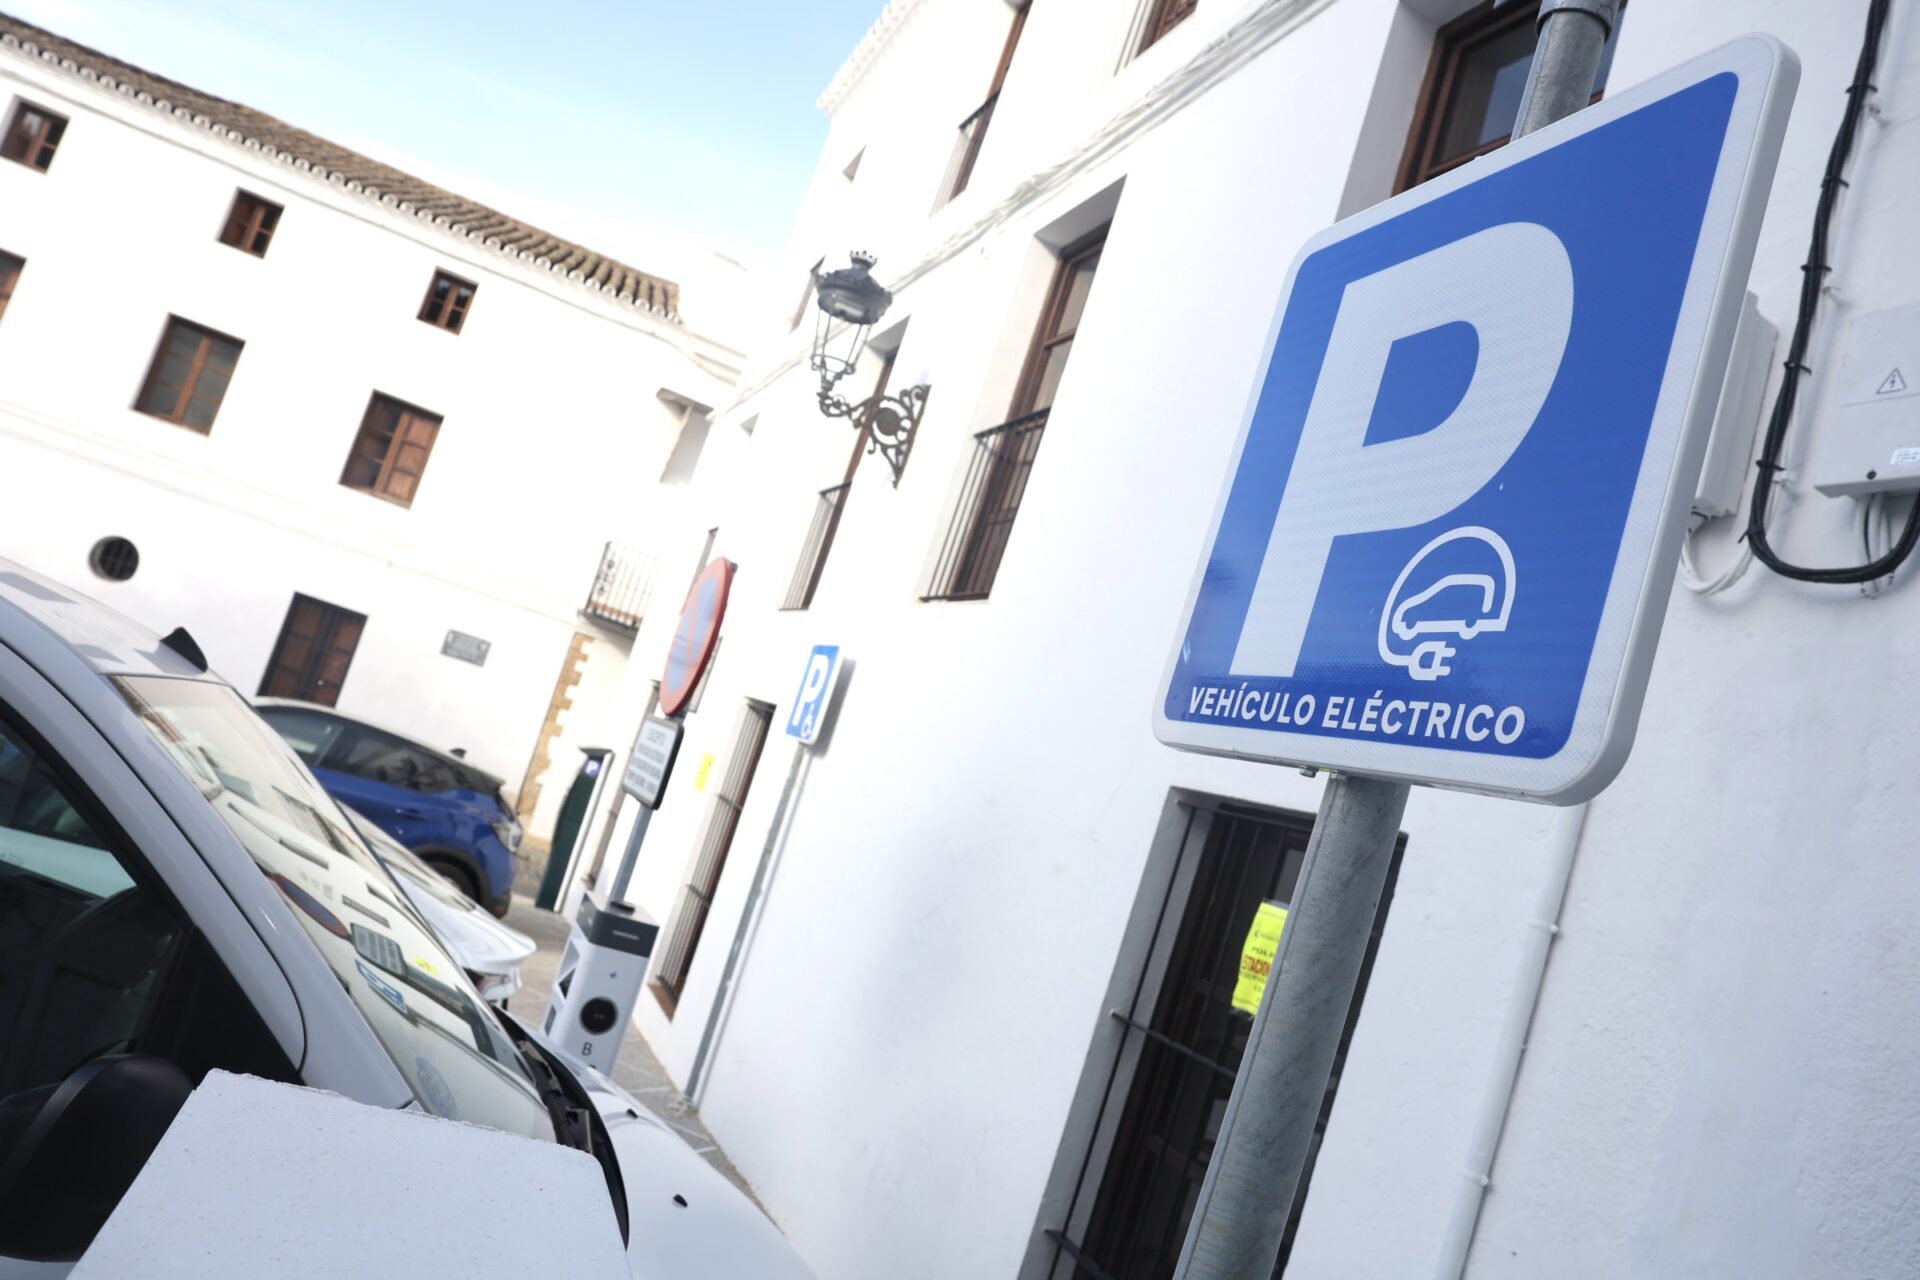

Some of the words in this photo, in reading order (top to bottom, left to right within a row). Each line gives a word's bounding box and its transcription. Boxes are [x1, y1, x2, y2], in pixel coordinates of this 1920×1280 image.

[1229, 222, 1574, 677] P
[792, 654, 829, 726] P
[1189, 682, 1315, 725] VEHÍCULO
[1322, 690, 1525, 744] ELÉCTRICO
[585, 760, 599, 774] P
